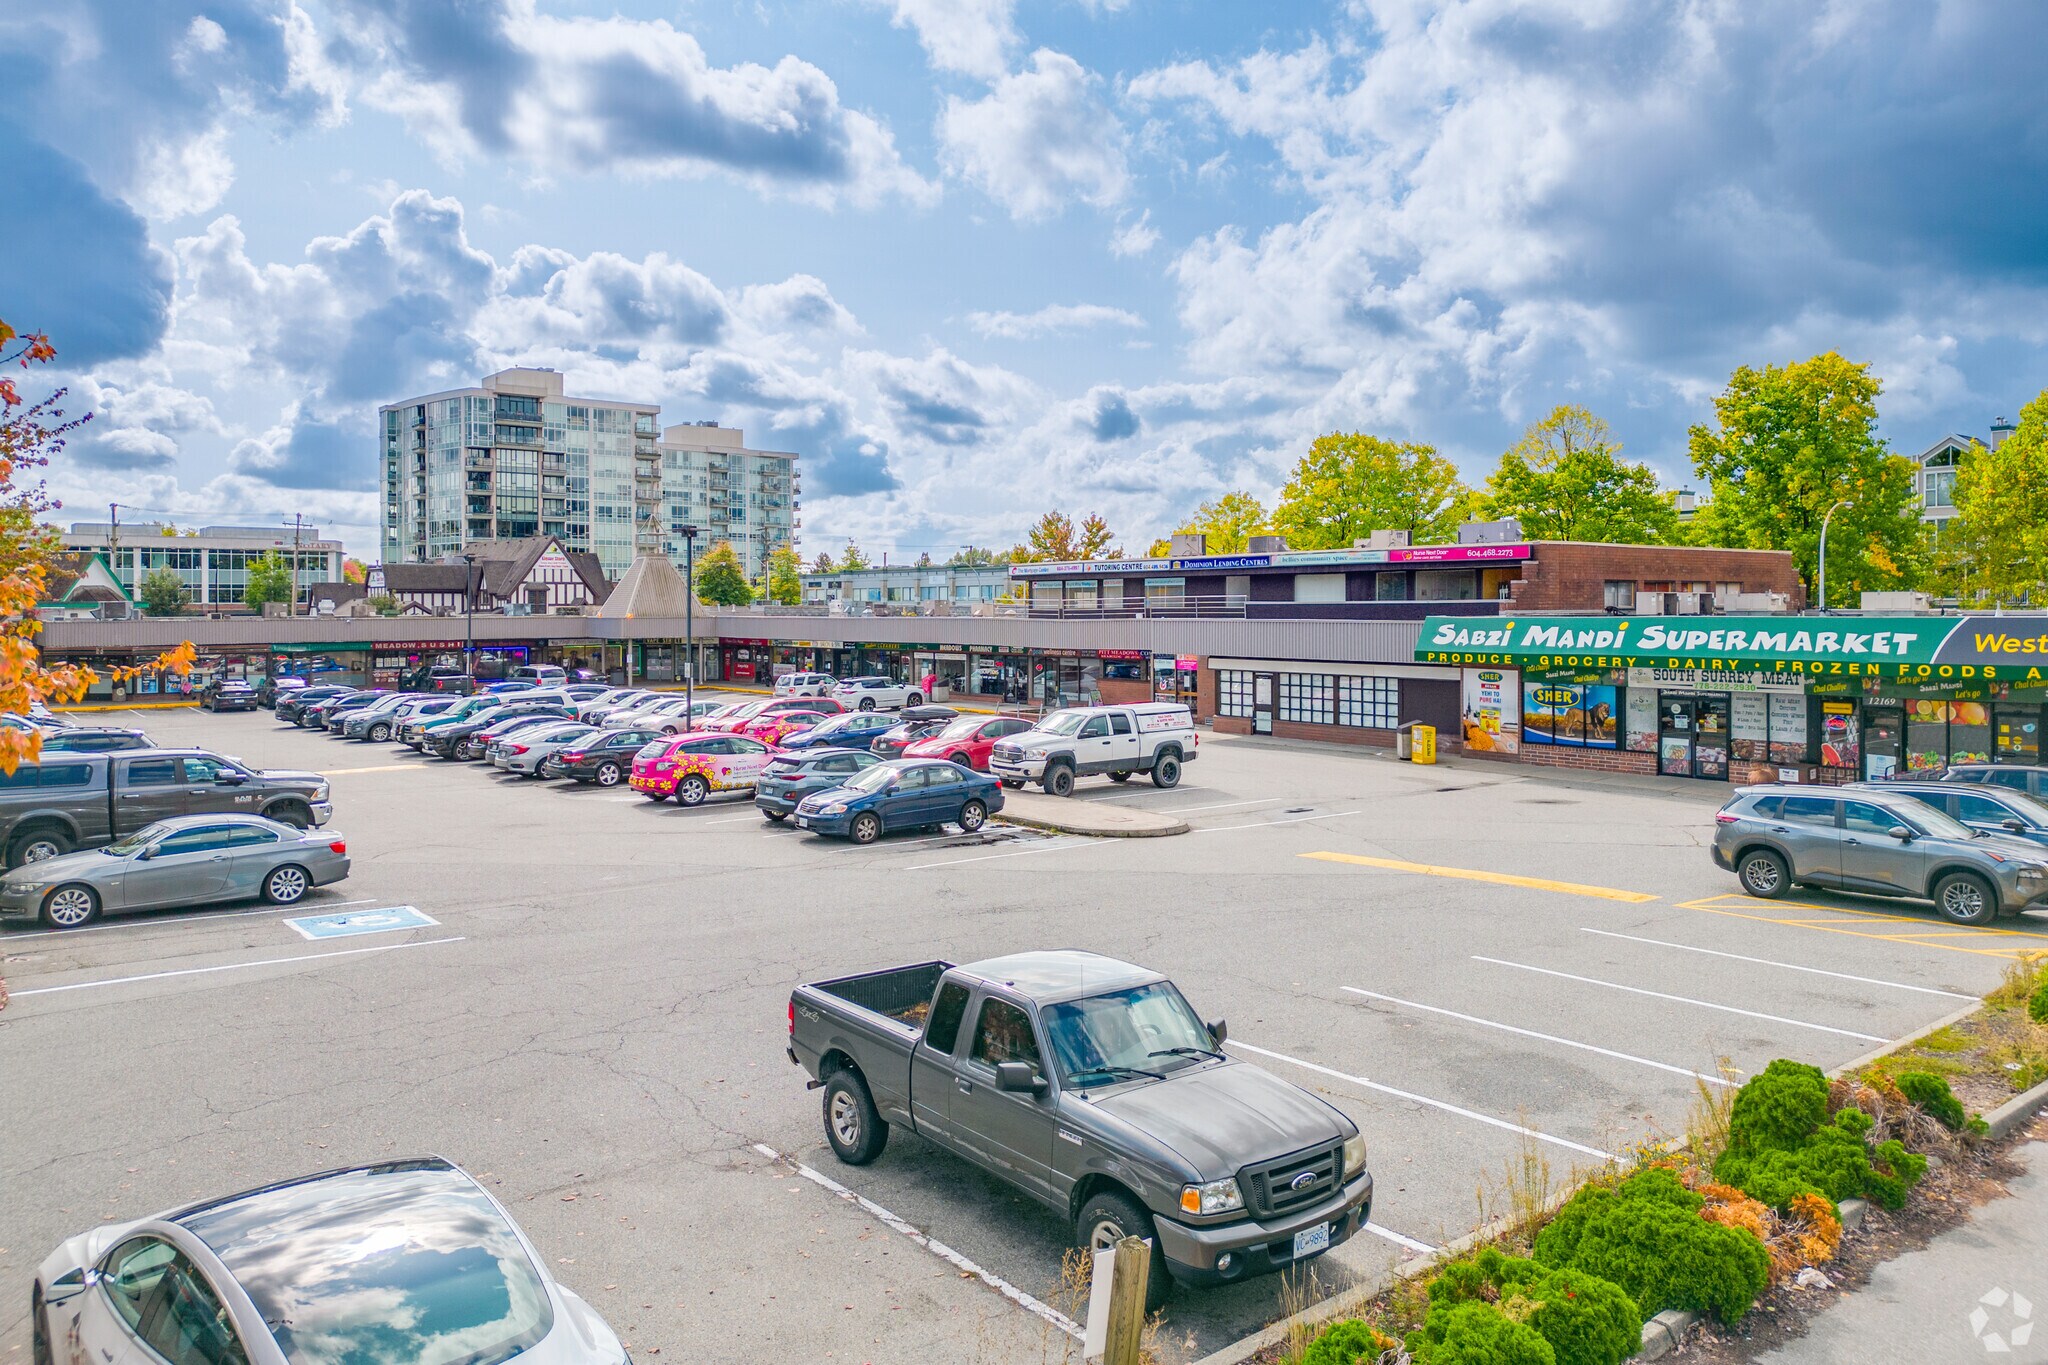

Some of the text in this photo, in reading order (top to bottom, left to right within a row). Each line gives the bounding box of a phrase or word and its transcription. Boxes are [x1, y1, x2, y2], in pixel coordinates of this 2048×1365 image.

[1467, 549, 1513, 557] 604.468.2273
[1240, 558, 1268, 566] CENTRES
[1636, 625, 1918, 655] SUPERMARKET
[1975, 633, 2048, 653] West
[1428, 652, 1512, 665] PRODUCE
[1540, 656, 1637, 668] GROCERY
[1668, 658, 1740, 670] DAIRY
[1775, 660, 1881, 676] FROZEN
[1898, 663, 1997, 679] FOODS
[1653, 668, 1695, 682] SOUTH
[1701, 669, 1754, 684] SURREY
[1761, 672, 1802, 686] MEAT
[1693, 682, 1756, 691] 778-222-2930
[1813, 685, 1825, 693] Chal
[1955, 690, 1981, 699] Let's go
[1537, 688, 1573, 704] SHER
[1869, 697, 1896, 705] 12169
[799, 1006, 820, 1022] 4x4
[1310, 1229, 1328, 1247] 9892
